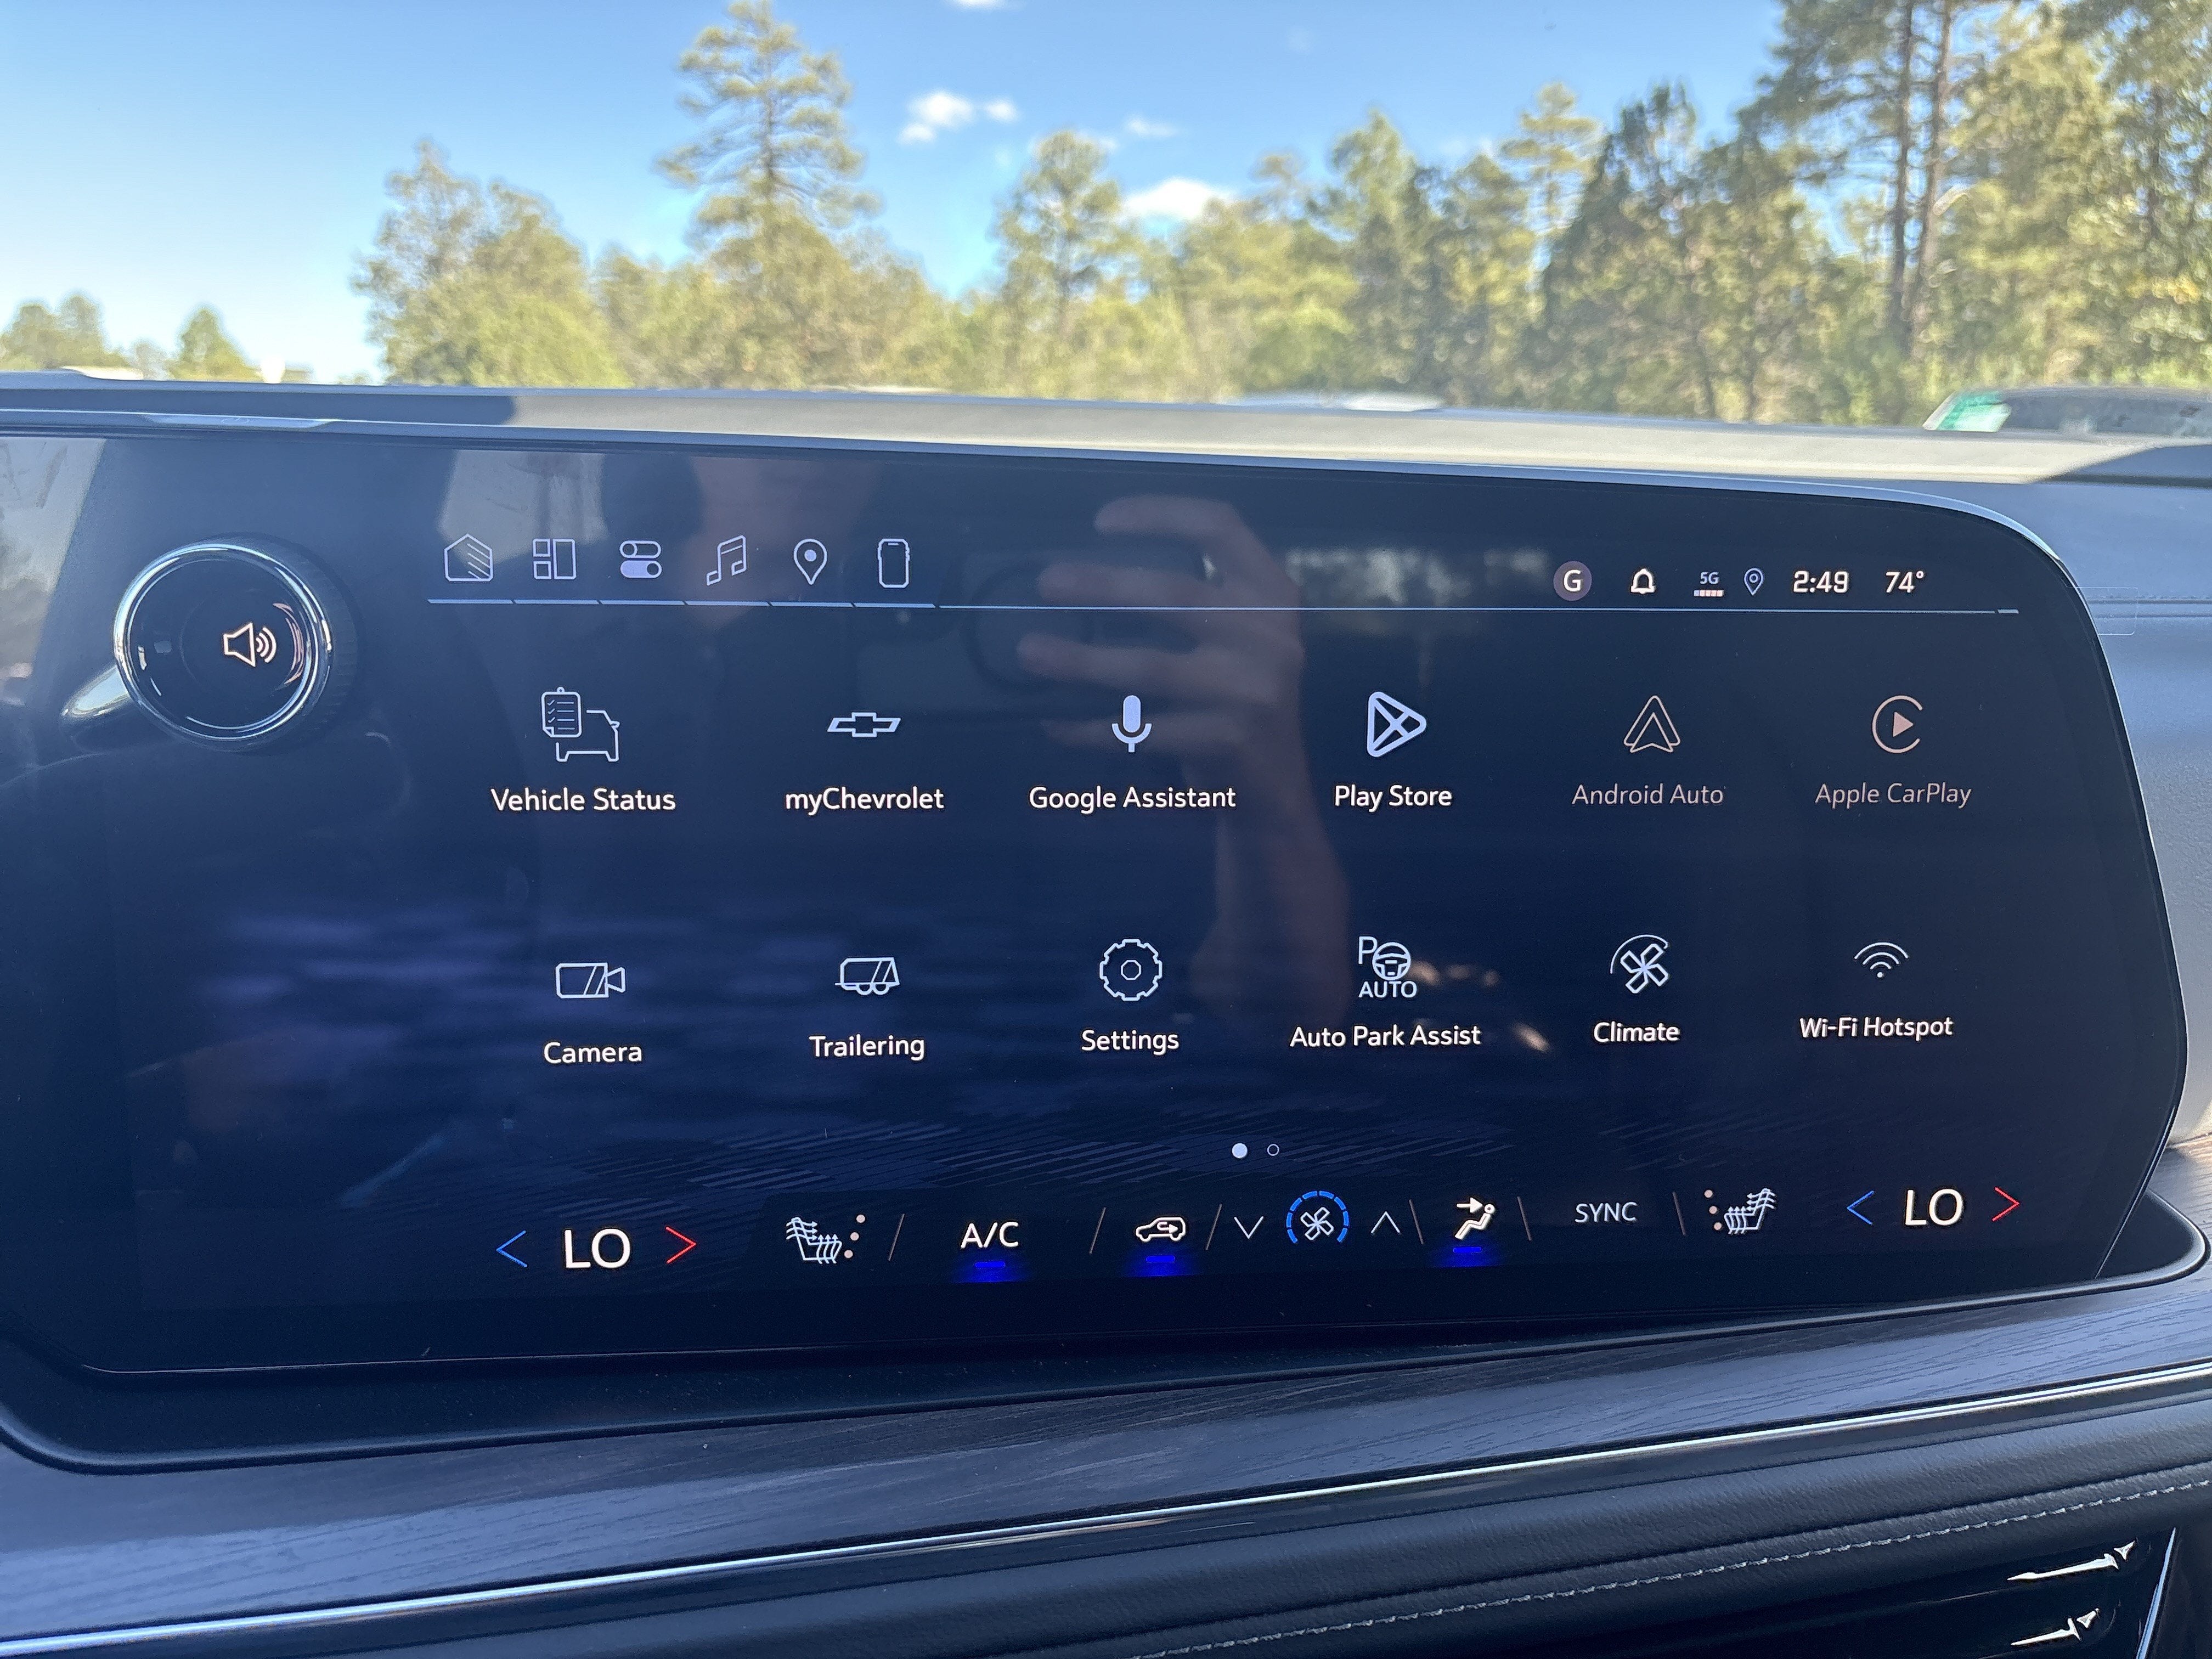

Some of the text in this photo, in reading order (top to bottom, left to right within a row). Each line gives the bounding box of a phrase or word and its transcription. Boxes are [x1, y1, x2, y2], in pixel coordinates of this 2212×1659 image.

[1563, 569, 1582, 592] G
[1699, 571, 1719, 585] 5G
[1793, 570, 1849, 594] 2:49
[489, 786, 676, 811] Vehicle Status
[785, 785, 945, 816] myChevrolet
[1029, 785, 1237, 815] Google Assistant
[1334, 783, 1453, 813] Play Store
[1571, 782, 1724, 805] Android Auto
[1814, 781, 1972, 810] Apple CarPlay
[1358, 935, 1378, 964] P
[1358, 980, 1417, 998] AUTO
[1289, 1023, 1482, 1048] Auto Park Assist
[1593, 1020, 1681, 1043] Climate
[1799, 1016, 1954, 1042] Wi-Fi Hotspot
[543, 1041, 642, 1064] Camera
[808, 1033, 925, 1062] Trailering
[1081, 1029, 1180, 1056] Settings
[1574, 1201, 1638, 1223] SYNC
[1904, 1188, 1963, 1226] LO
[960, 1221, 1019, 1249] A/C
[563, 1228, 631, 1269] LO
